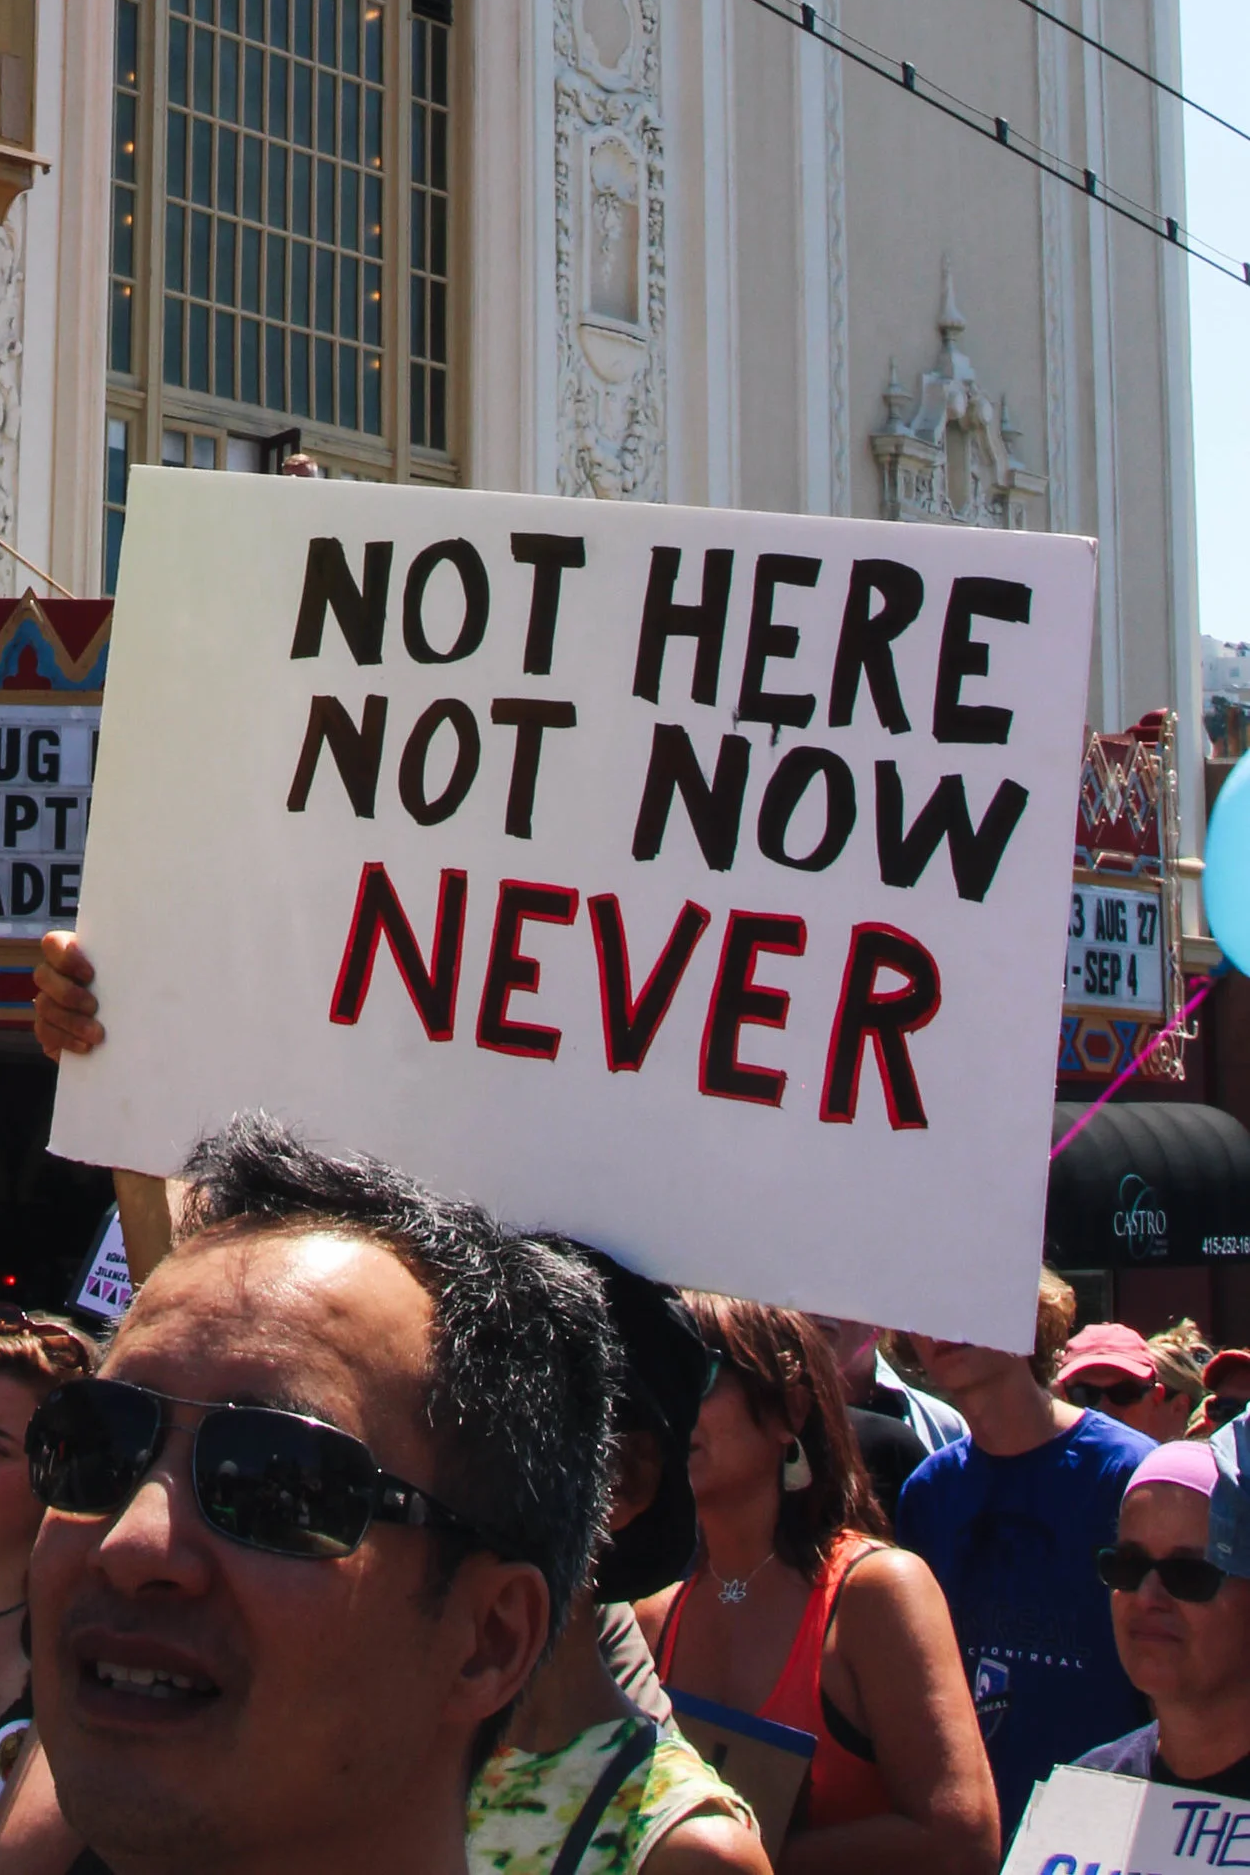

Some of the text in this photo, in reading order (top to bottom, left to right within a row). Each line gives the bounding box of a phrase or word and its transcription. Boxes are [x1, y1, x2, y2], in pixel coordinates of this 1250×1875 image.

[290, 532, 1033, 745] NOT HERE
[286, 694, 1030, 903] NOT NOW
[1068, 893, 1158, 945] 3 AUG 27
[329, 861, 941, 1131] NEVER
[1127, 952, 1138, 997] 4
[1113, 1209, 1167, 1237] CASTRO
[1202, 1236, 1250, 1256] 415-252-16
